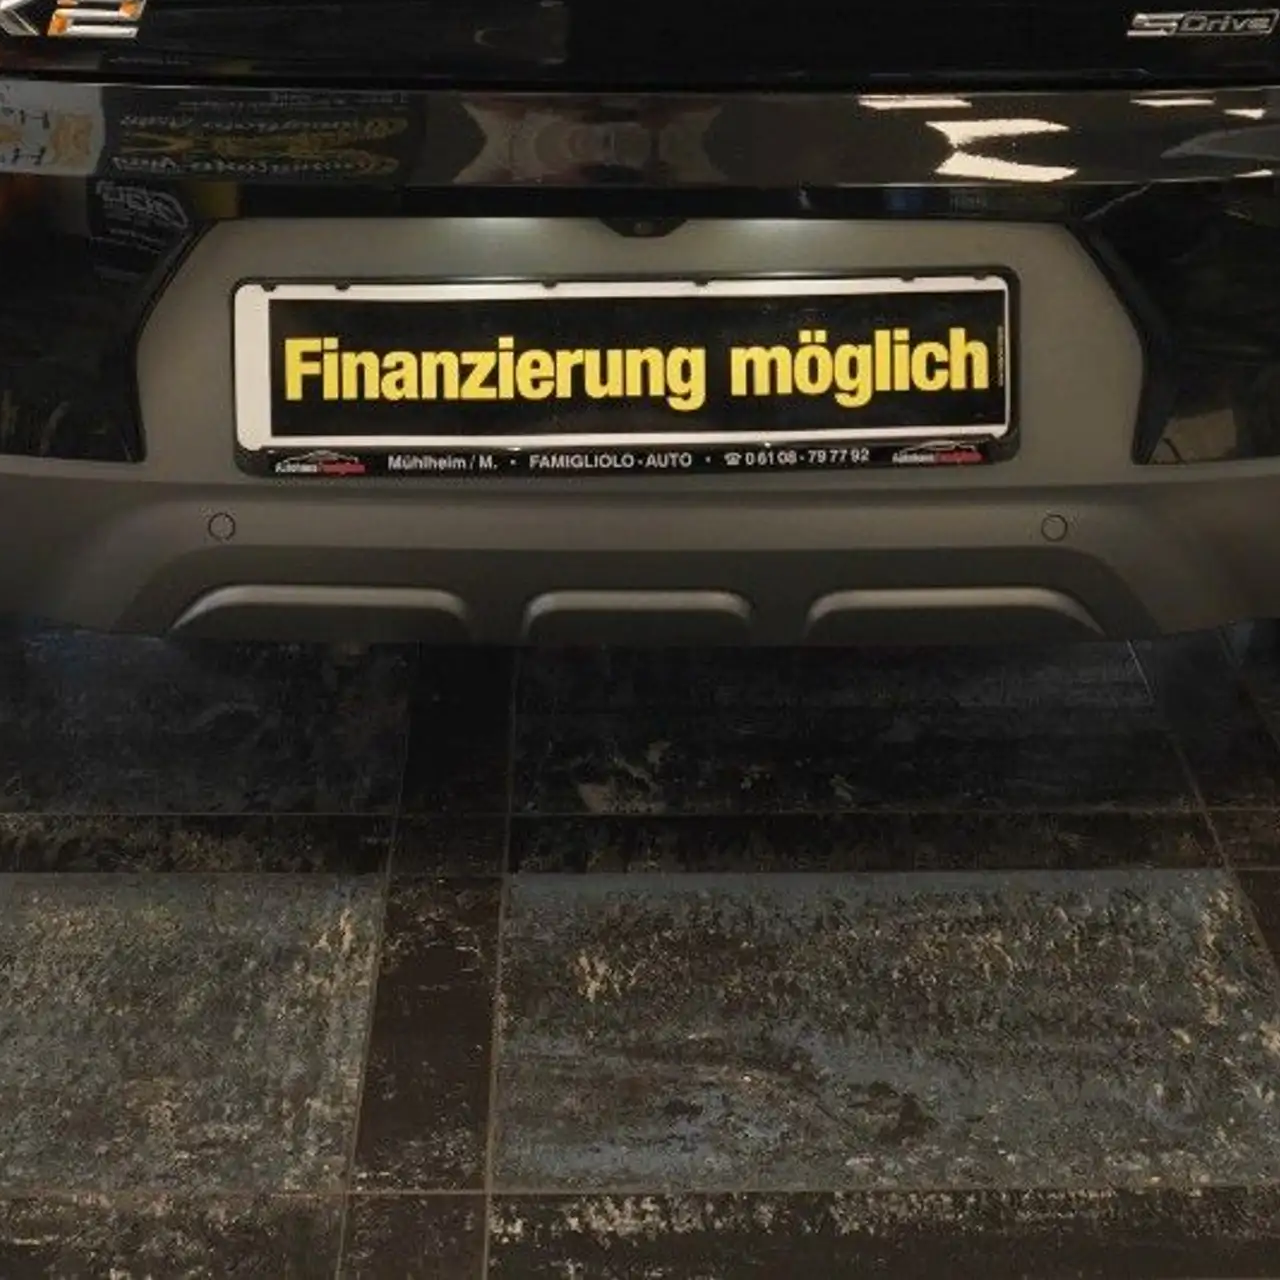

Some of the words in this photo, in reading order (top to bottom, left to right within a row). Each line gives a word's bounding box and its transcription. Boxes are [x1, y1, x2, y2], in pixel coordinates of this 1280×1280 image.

[284, 335, 707, 411] Finanzierung
[730, 327, 989, 408] möglich
[387, 454, 467, 470] Mühlheim
